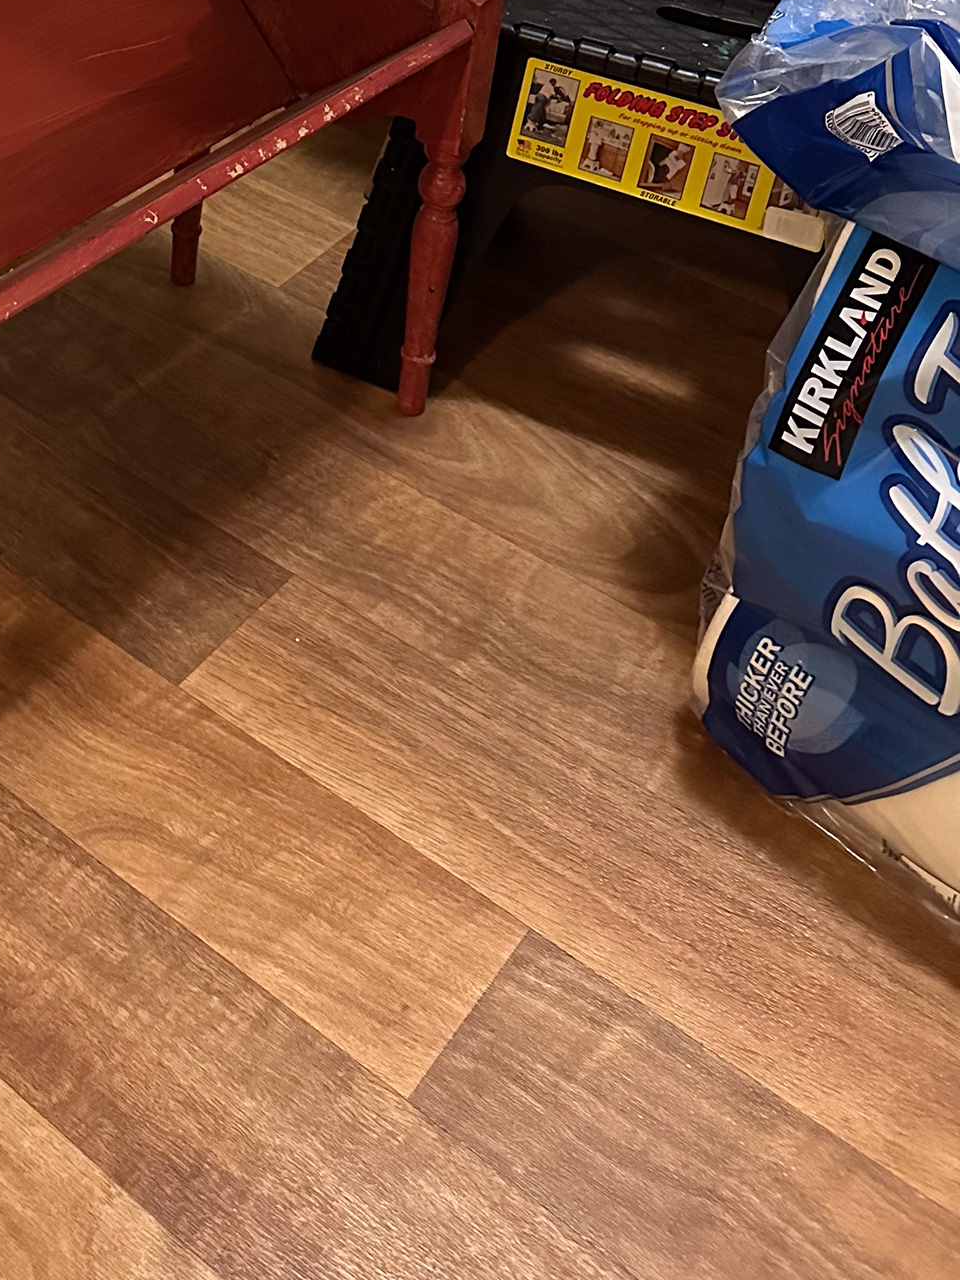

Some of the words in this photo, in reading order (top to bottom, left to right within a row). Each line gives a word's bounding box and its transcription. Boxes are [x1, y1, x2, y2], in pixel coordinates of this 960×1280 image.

[544, 63, 573, 76] STURDY
[583, 82, 667, 119] FOLDING
[665, 106, 719, 131] STEP
[536, 144, 550, 154] 300
[551, 148, 563, 158] lbs
[633, 115, 666, 133] stepping
[667, 127, 680, 137] up
[689, 133, 719, 149] sitting
[719, 141, 742, 153] down
[535, 151, 562, 164] capacity
[639, 190, 677, 206] STORABLE
[781, 248, 901, 454] KIRKLAND
[823, 264, 925, 466] Signature
[753, 701, 772, 737] THAN
[765, 661, 789, 700] EVER
[765, 665, 813, 757] BEFORE
